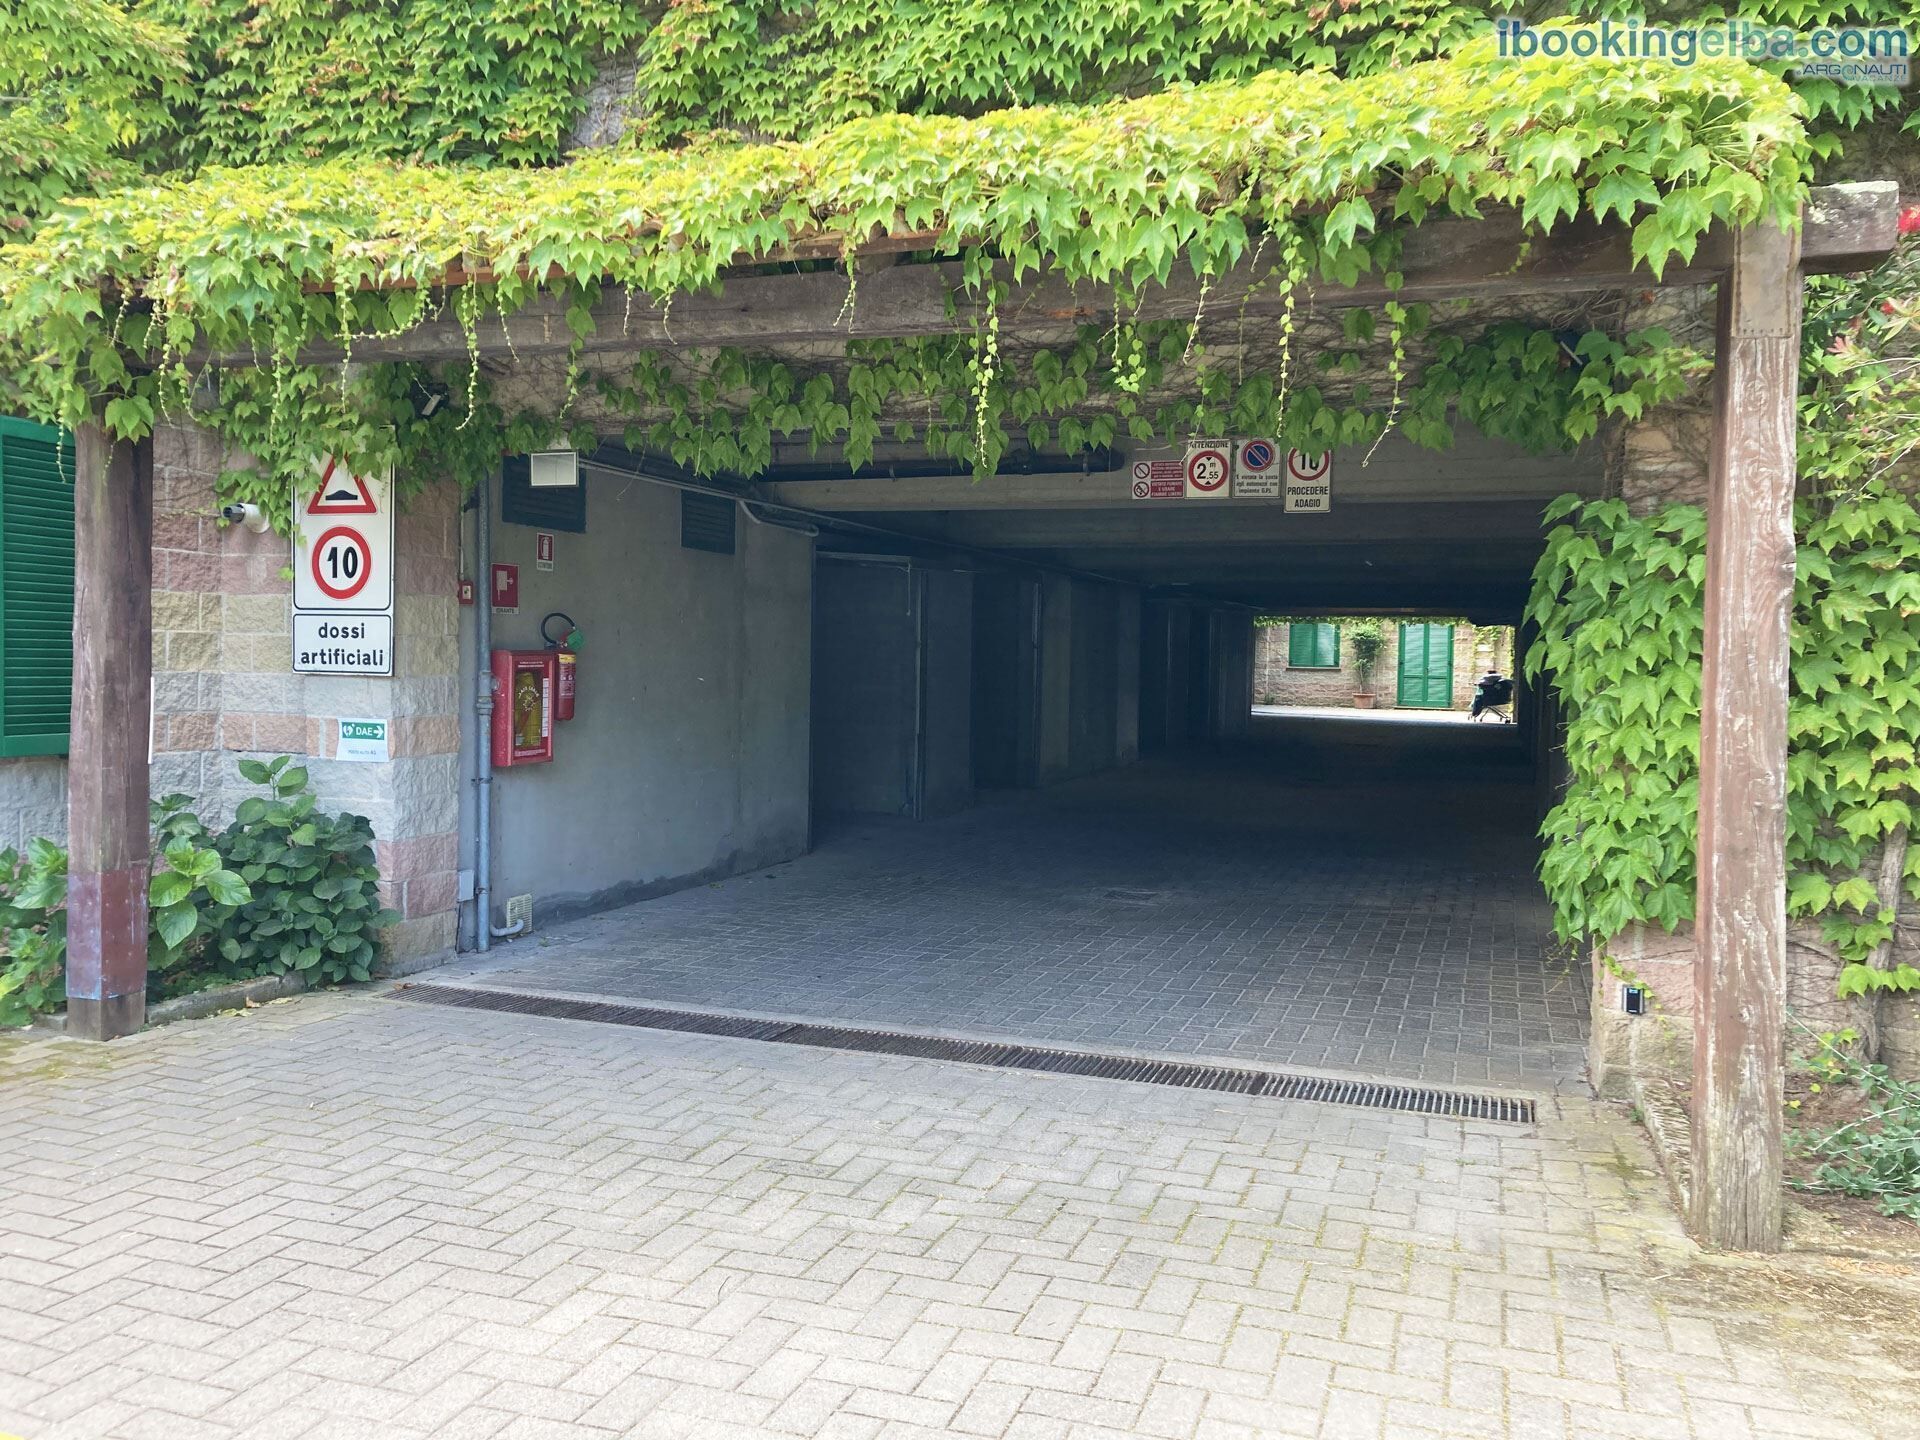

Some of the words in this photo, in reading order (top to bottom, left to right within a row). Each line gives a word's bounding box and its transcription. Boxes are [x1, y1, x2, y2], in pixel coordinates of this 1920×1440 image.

[1189, 440, 1229, 449] ATTENZIONE
[1287, 486, 1329, 496] PROCEDERE
[1294, 498, 1321, 508] ADAGIO
[326, 546, 359, 579] 10
[317, 622, 366, 640] dossi
[300, 648, 384, 667] artificiali
[355, 726, 373, 736] DAE
